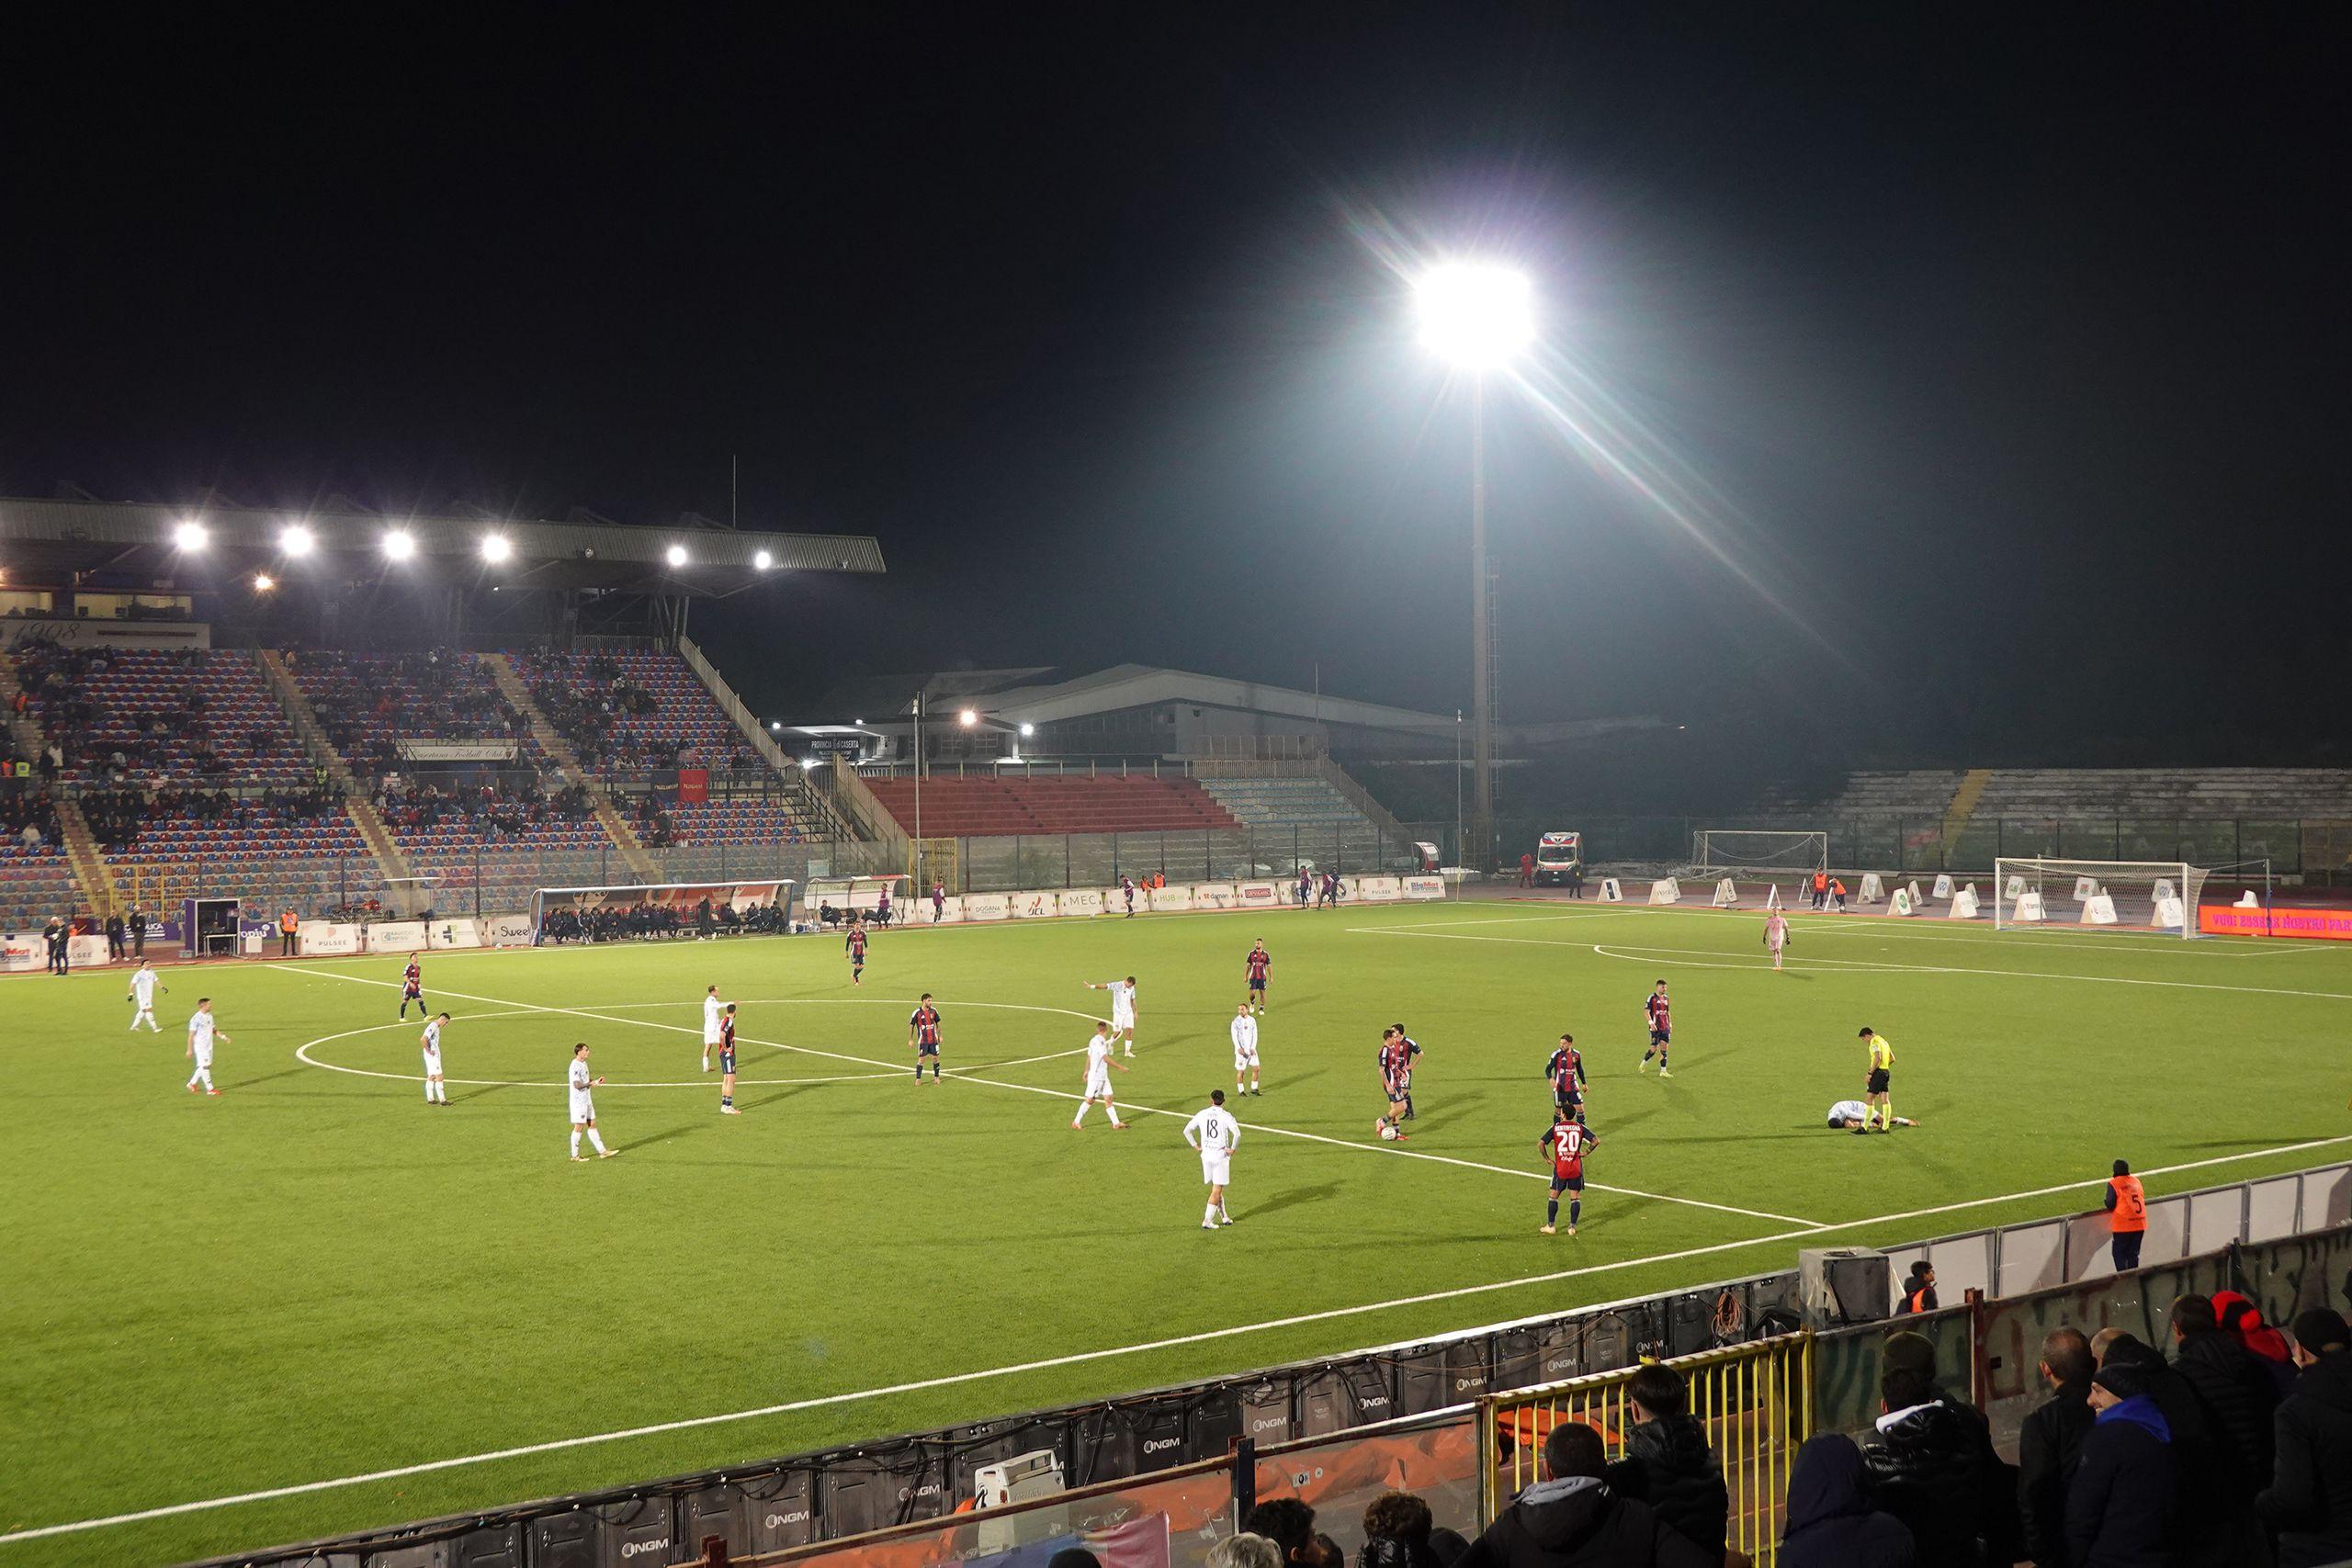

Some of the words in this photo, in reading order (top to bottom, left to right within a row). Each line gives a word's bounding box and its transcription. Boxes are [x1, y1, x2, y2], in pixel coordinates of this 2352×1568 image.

[1069, 895, 1096, 906] MEC
[1159, 894, 1176, 902] HUB
[2239, 914, 2280, 930] ESSEE
[2328, 918, 2352, 931] PAR
[1206, 1119, 1218, 1139] 18
[1556, 1131, 1580, 1153] 20
[2132, 1194, 2143, 1214] 5
